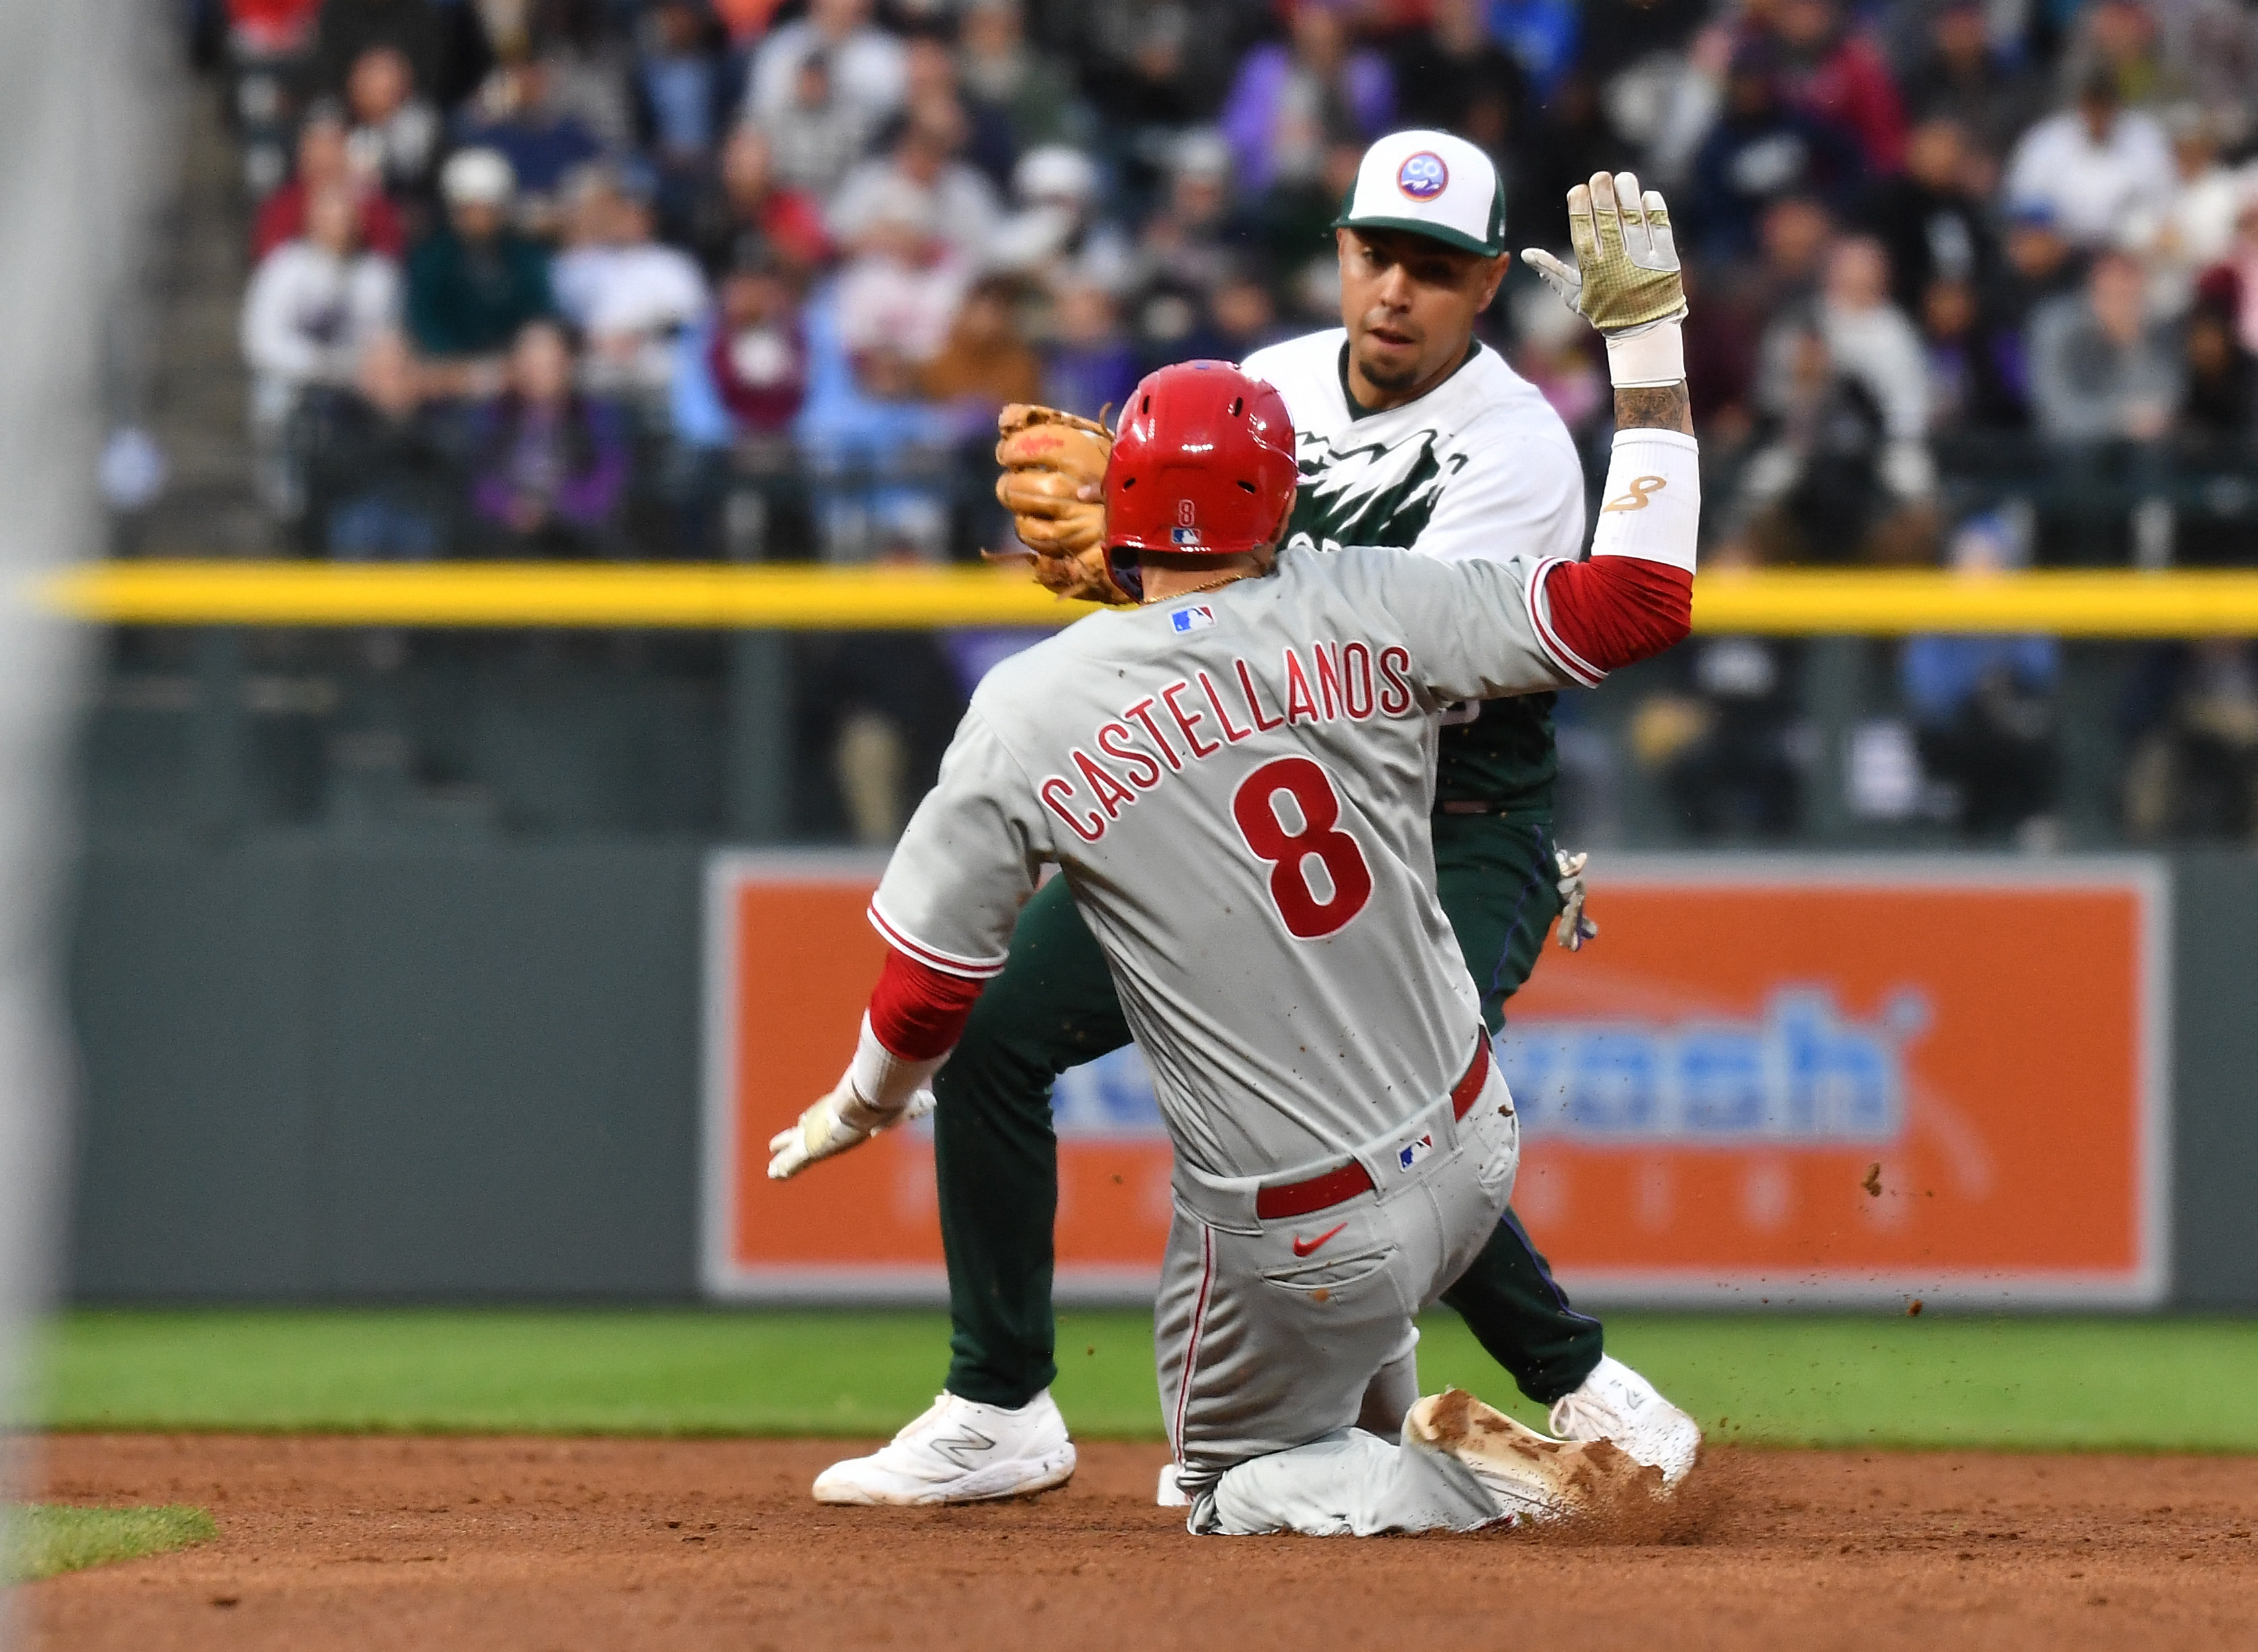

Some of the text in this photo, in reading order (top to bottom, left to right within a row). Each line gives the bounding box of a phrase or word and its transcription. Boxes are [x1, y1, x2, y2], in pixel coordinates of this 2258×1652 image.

[1408, 158, 1440, 177] CO
[1177, 499, 1195, 526] 8
[1602, 475, 1667, 513] 8
[1040, 640, 1414, 844] CASTELLANOS
[1232, 754, 1375, 941] 8
